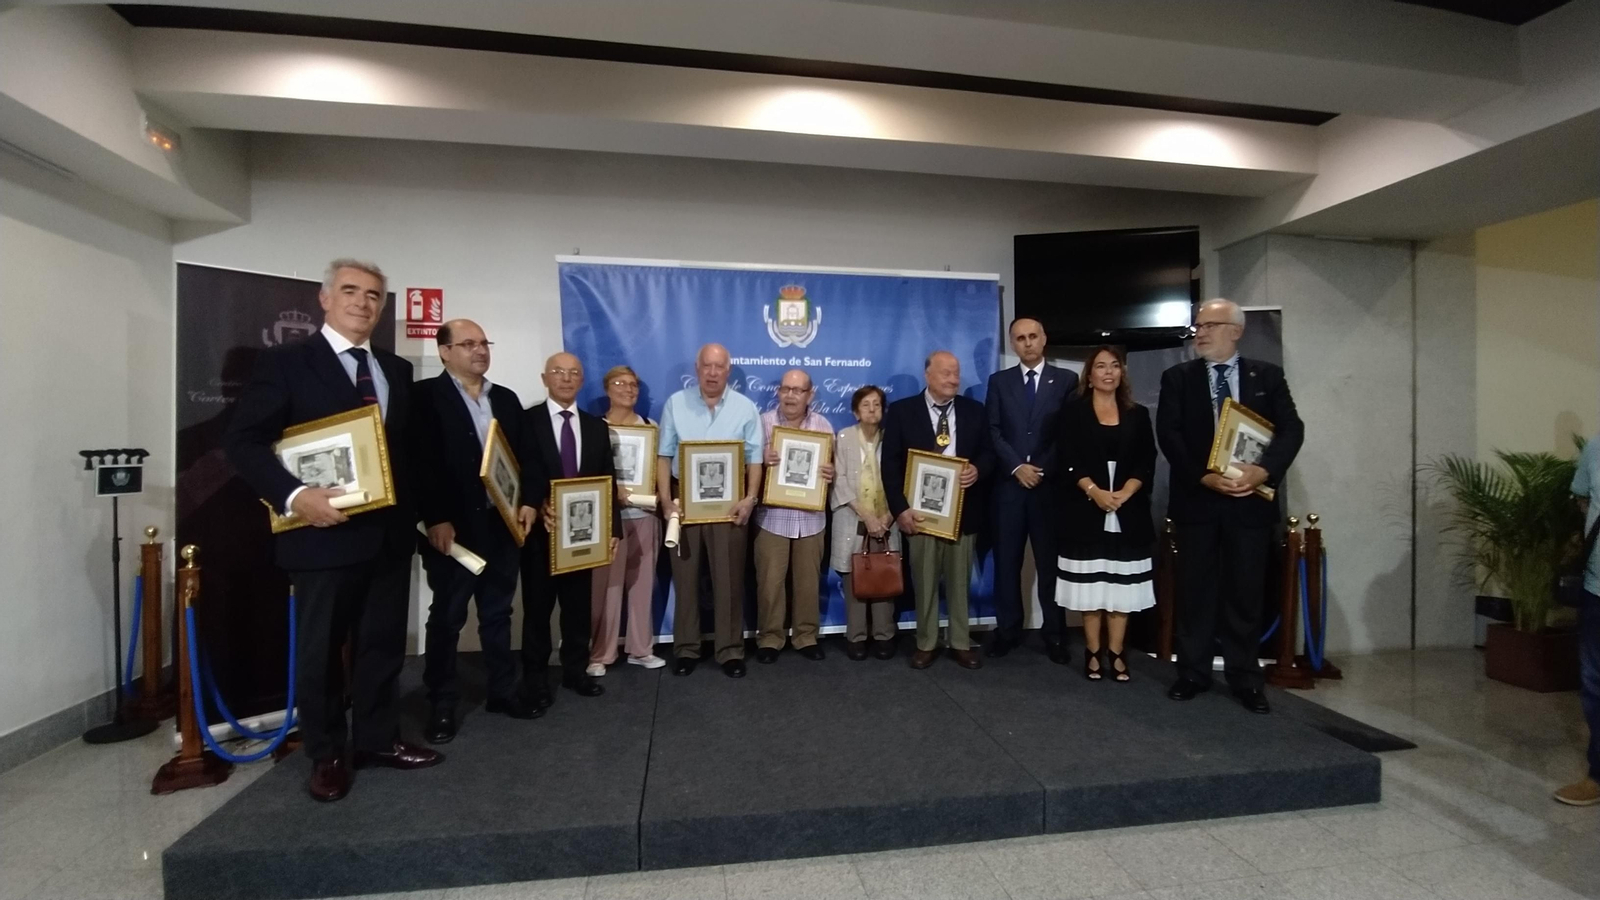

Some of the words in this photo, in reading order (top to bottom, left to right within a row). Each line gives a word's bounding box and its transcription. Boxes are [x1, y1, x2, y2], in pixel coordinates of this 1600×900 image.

[407, 328, 439, 336] EXTINTO
[789, 356, 802, 366] de
[804, 356, 822, 367] San
[825, 357, 872, 367] Fernando
[832, 402, 846, 414] de
